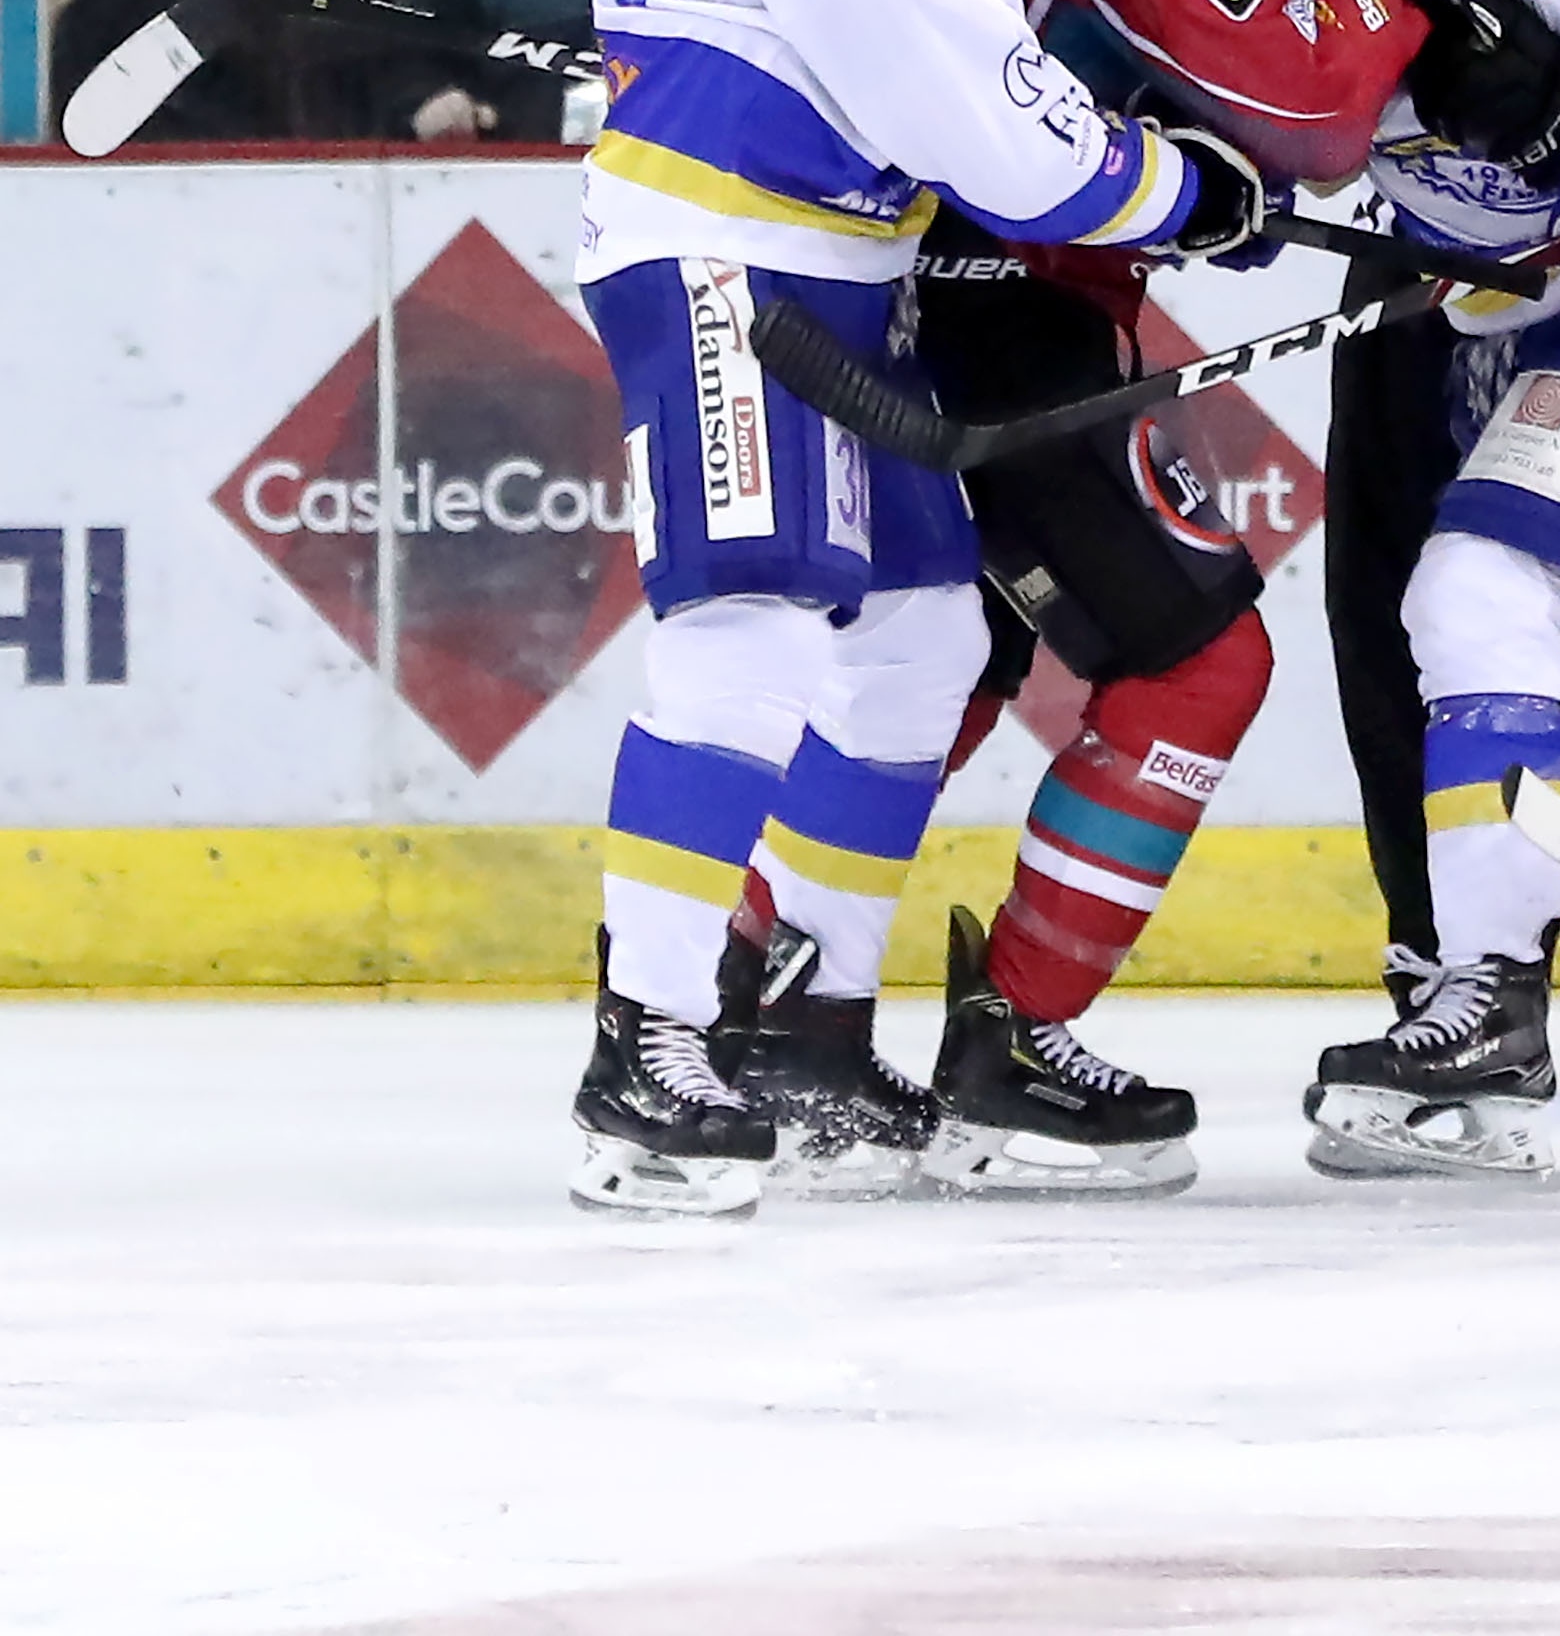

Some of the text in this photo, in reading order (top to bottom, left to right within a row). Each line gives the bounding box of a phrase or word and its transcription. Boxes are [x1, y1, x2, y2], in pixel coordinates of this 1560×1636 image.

[916, 256, 1029, 281] AUER
[1176, 300, 1386, 398] CCM
[733, 400, 760, 491] Doors
[242, 458, 634, 533] CastleCou
[1148, 750, 1219, 794] Belfas
